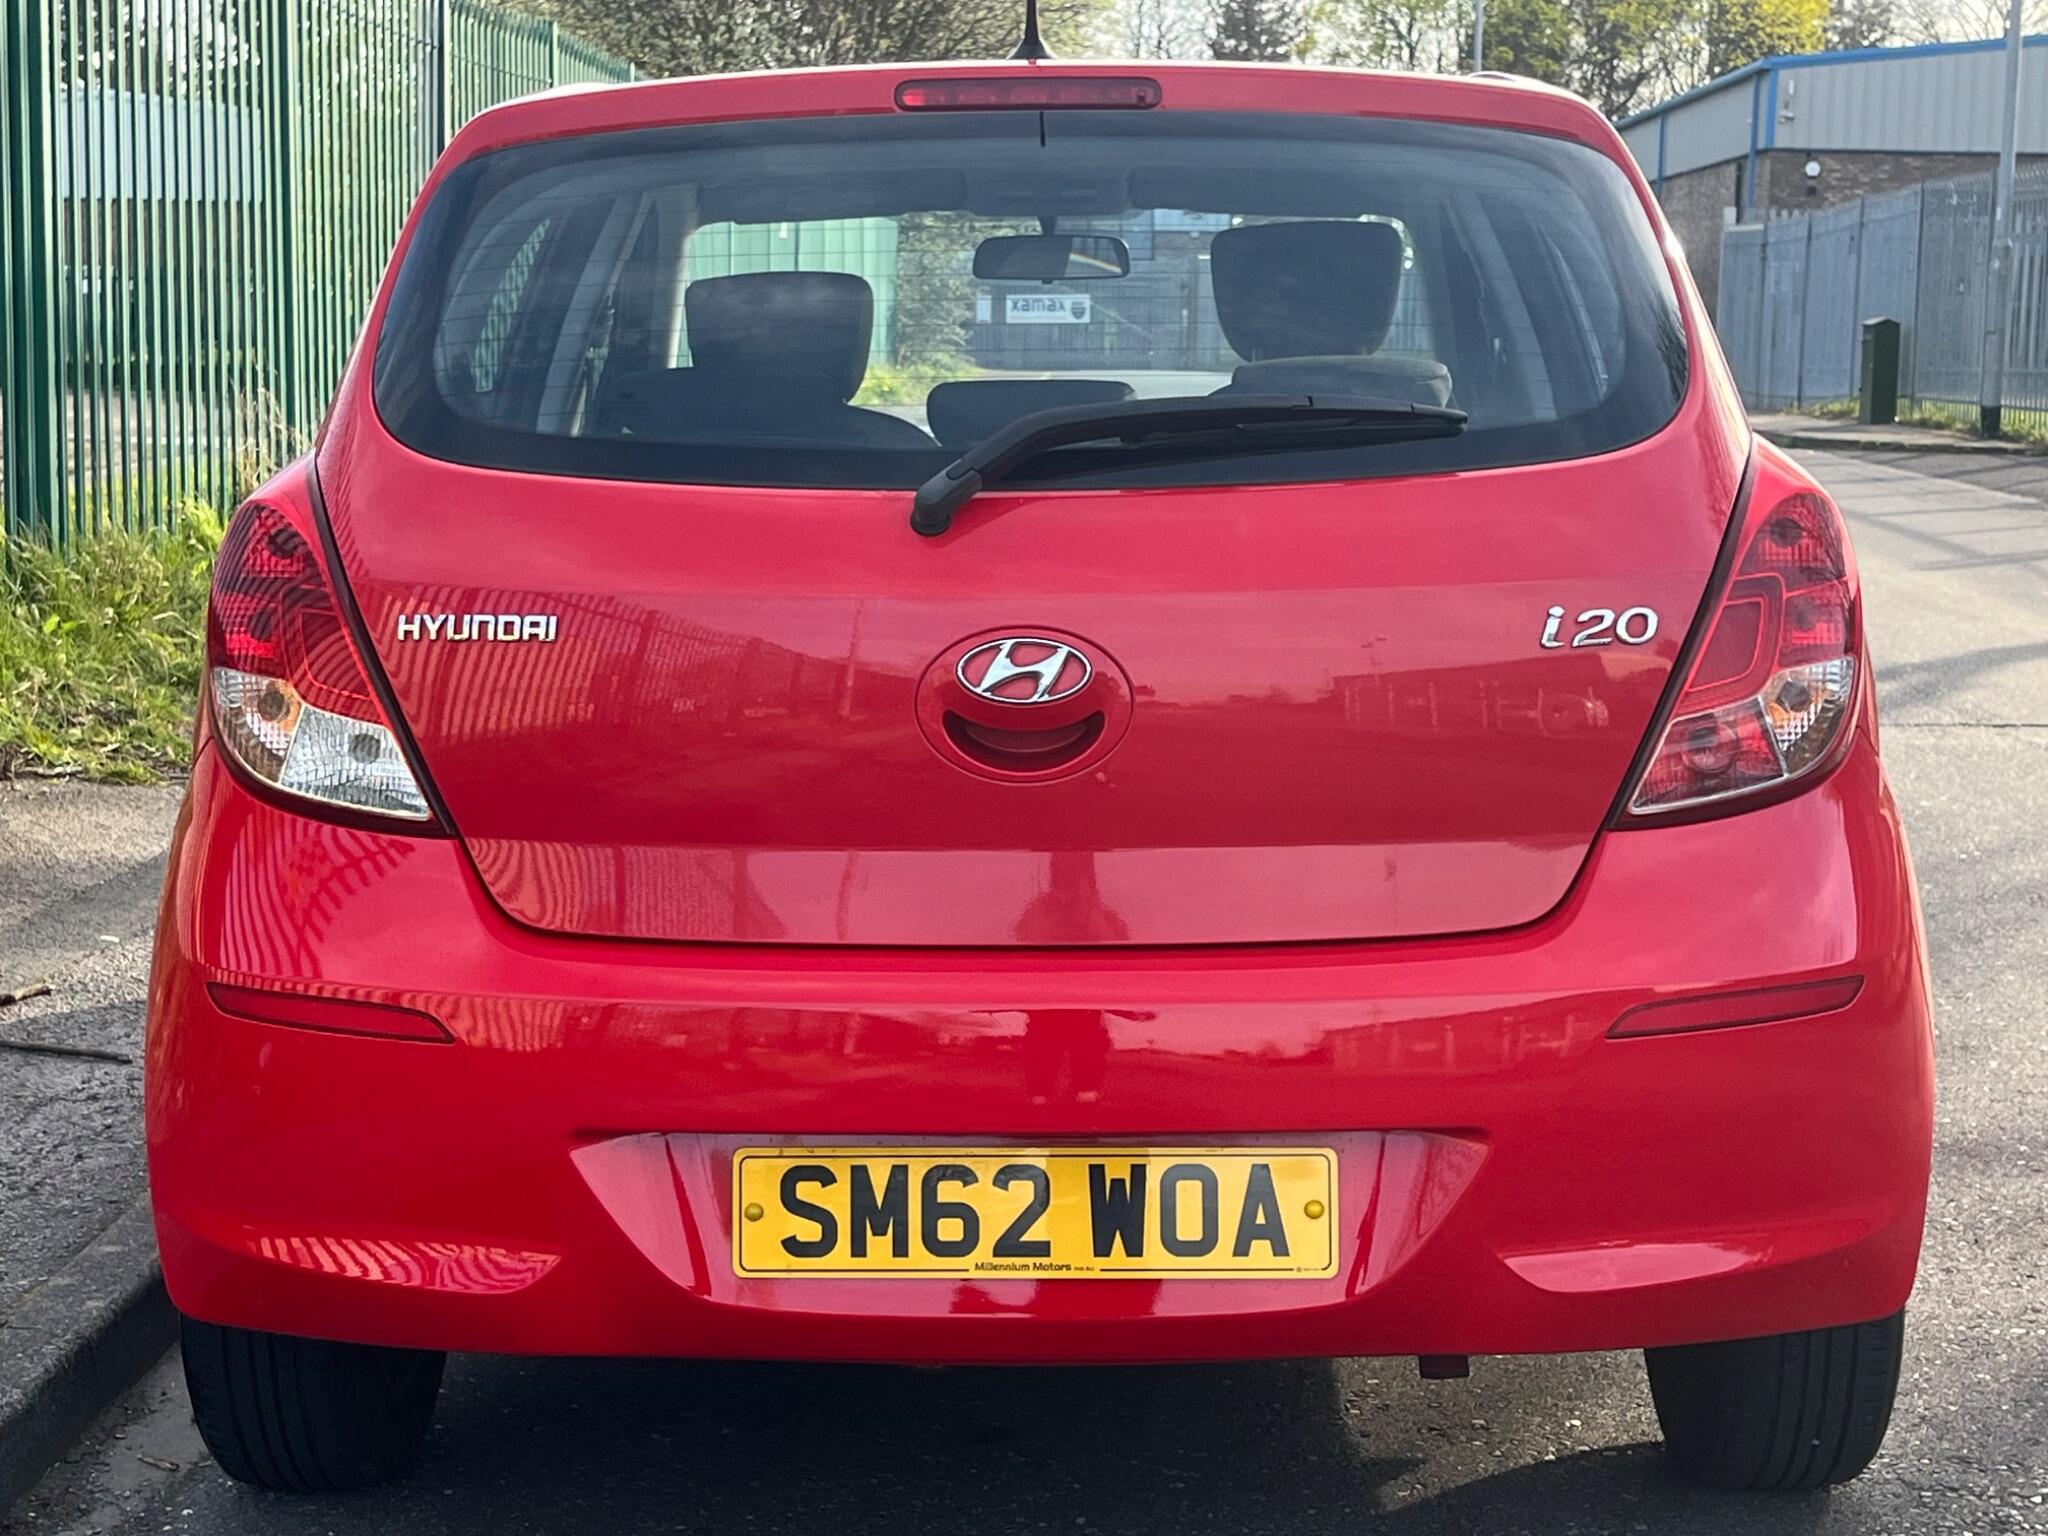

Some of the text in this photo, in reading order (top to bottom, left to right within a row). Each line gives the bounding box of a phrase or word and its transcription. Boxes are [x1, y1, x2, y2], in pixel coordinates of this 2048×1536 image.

[1011, 298, 1066, 312] xamax
[396, 613, 558, 642] HYUNDAI
[1541, 605, 1659, 648] i20
[778, 1163, 1291, 1258] SM62 WOA
[974, 1261, 1031, 1272] Millennium
[1032, 1261, 1072, 1272] Motors
